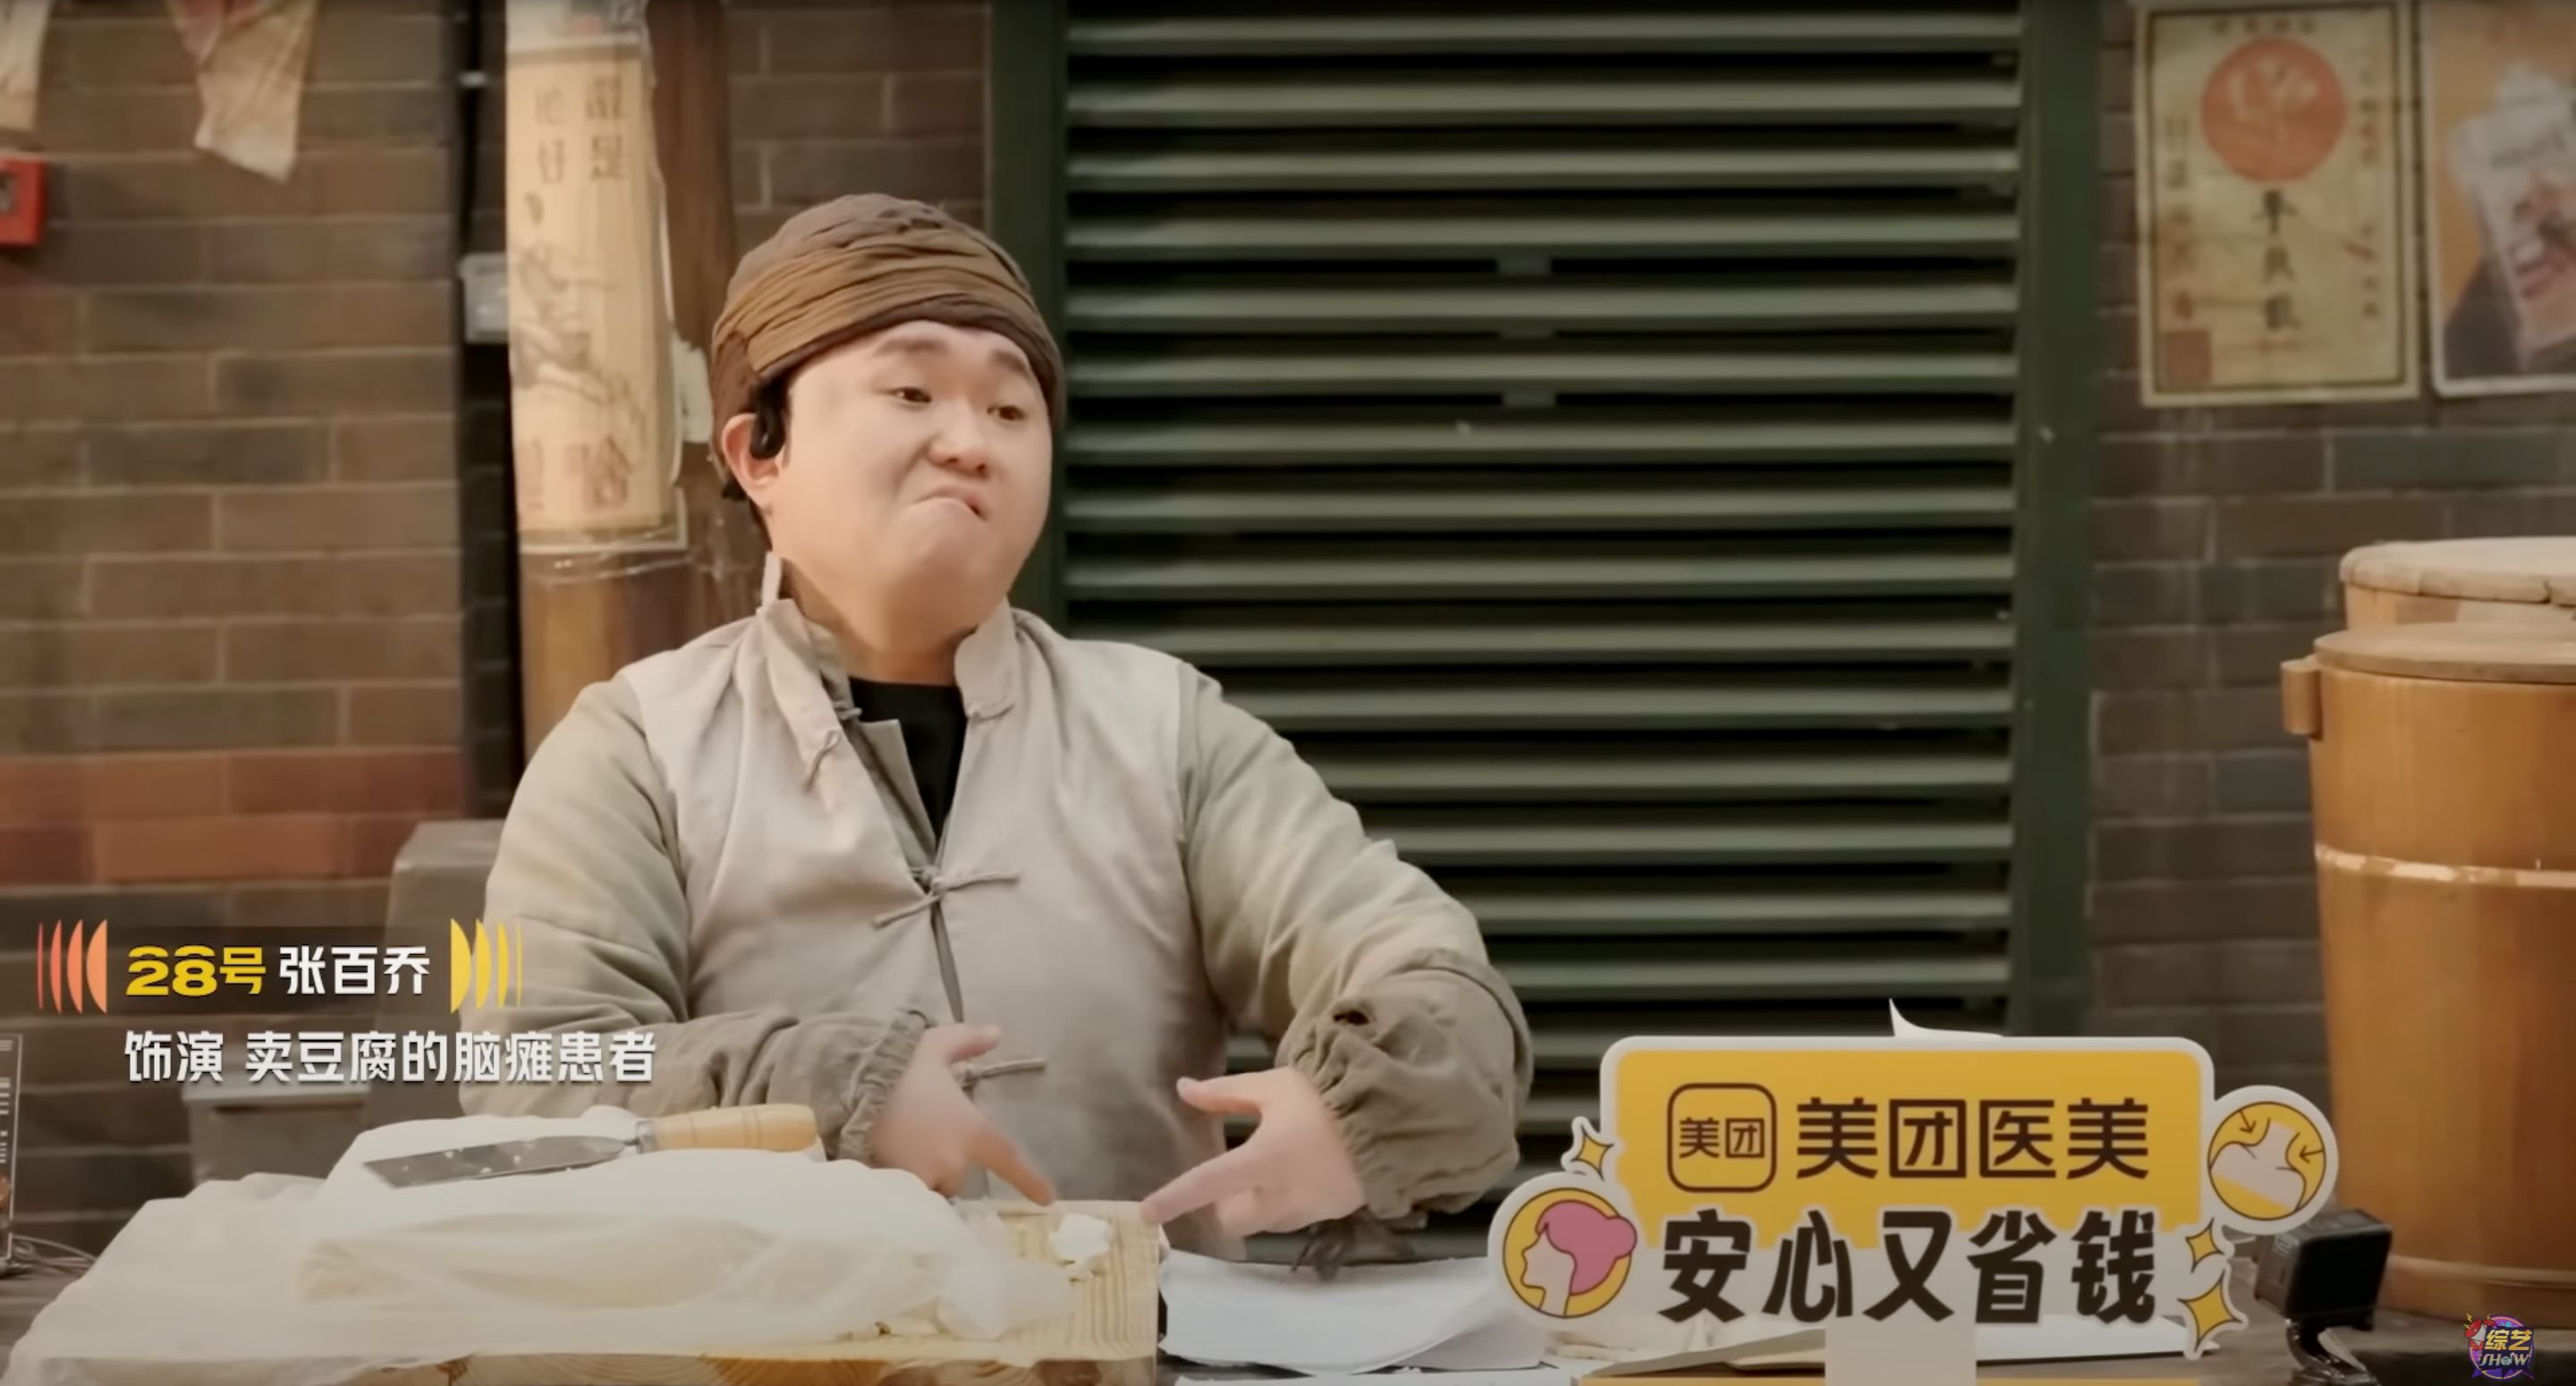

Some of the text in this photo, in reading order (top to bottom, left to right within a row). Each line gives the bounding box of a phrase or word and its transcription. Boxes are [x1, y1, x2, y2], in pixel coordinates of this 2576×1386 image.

[1679, 1116, 1766, 1160] 美团
[1795, 1097, 2148, 1179] 美团医美
[1658, 1209, 2157, 1324] 安心又省钱
